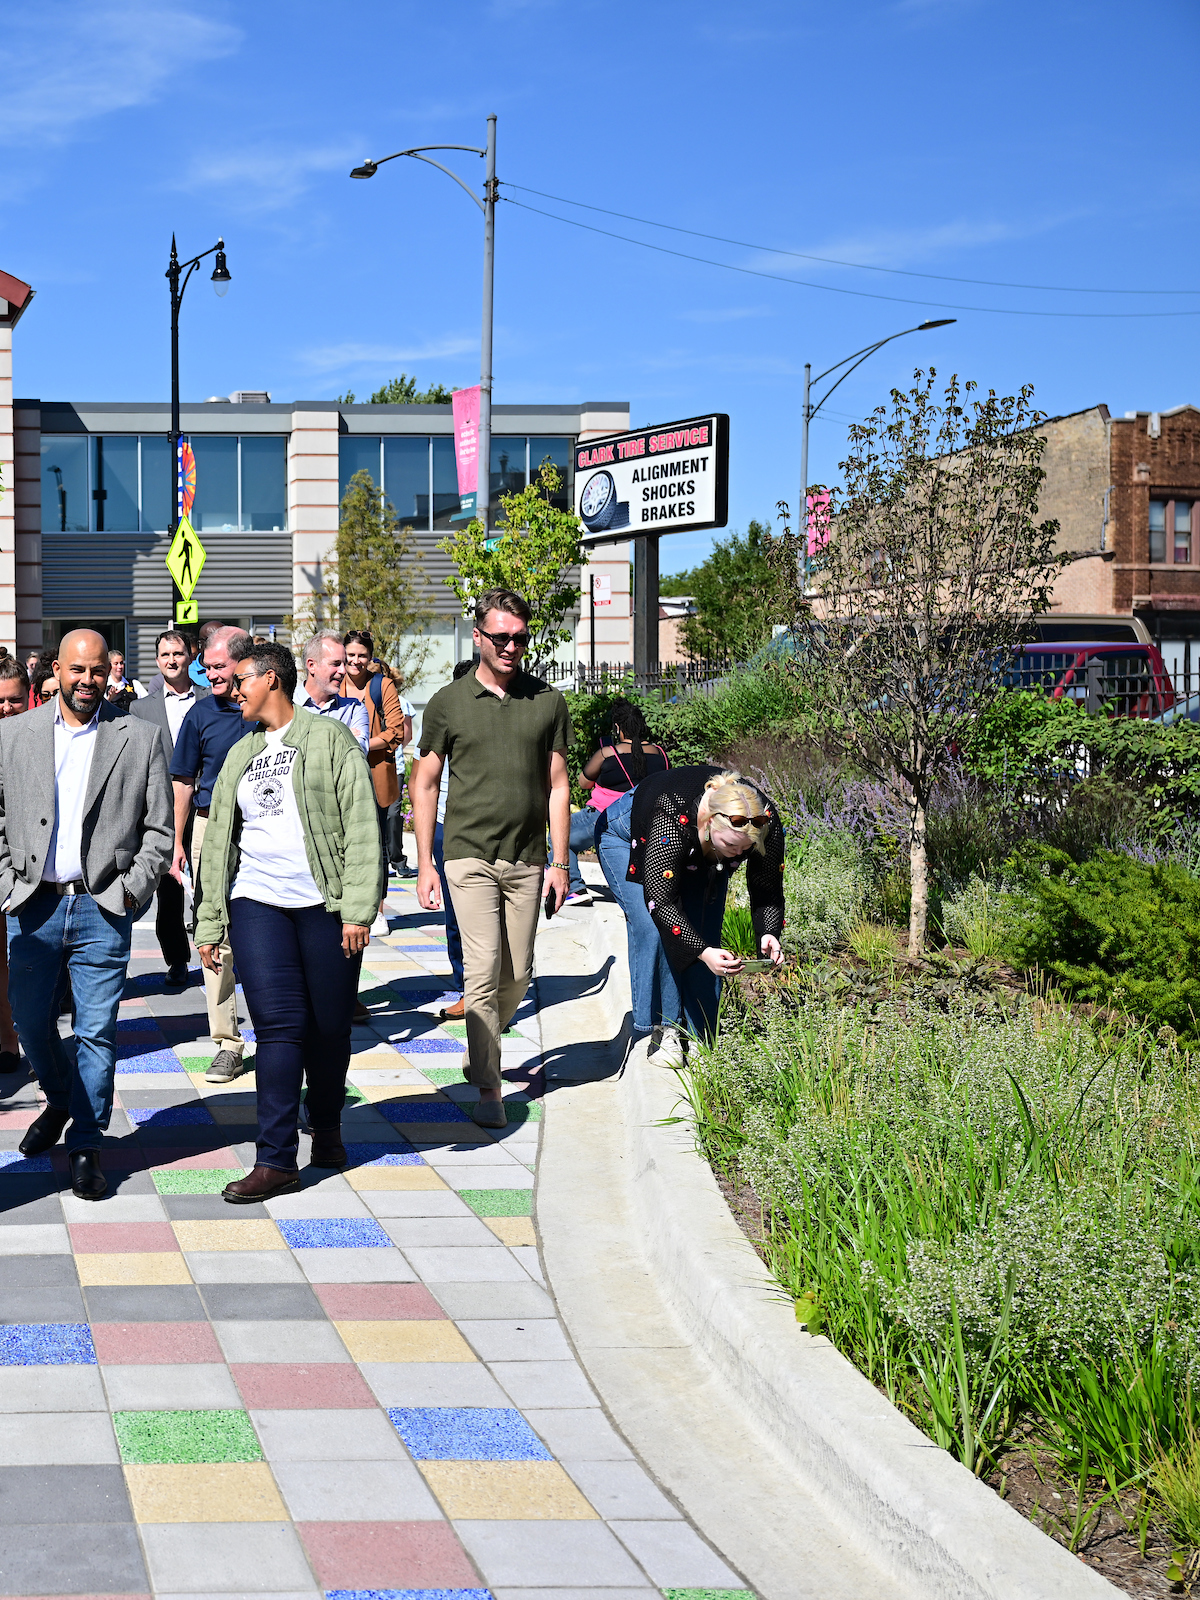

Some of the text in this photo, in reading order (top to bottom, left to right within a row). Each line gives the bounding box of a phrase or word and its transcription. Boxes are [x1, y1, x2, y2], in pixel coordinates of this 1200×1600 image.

[578, 425, 709, 468] CLARK TIRE SERVICE
[632, 456, 709, 484] ALIGNMENT
[642, 480, 696, 502] SHOCKS
[641, 501, 696, 523] BRAKES
[248, 766, 290, 782] CHICAGO
